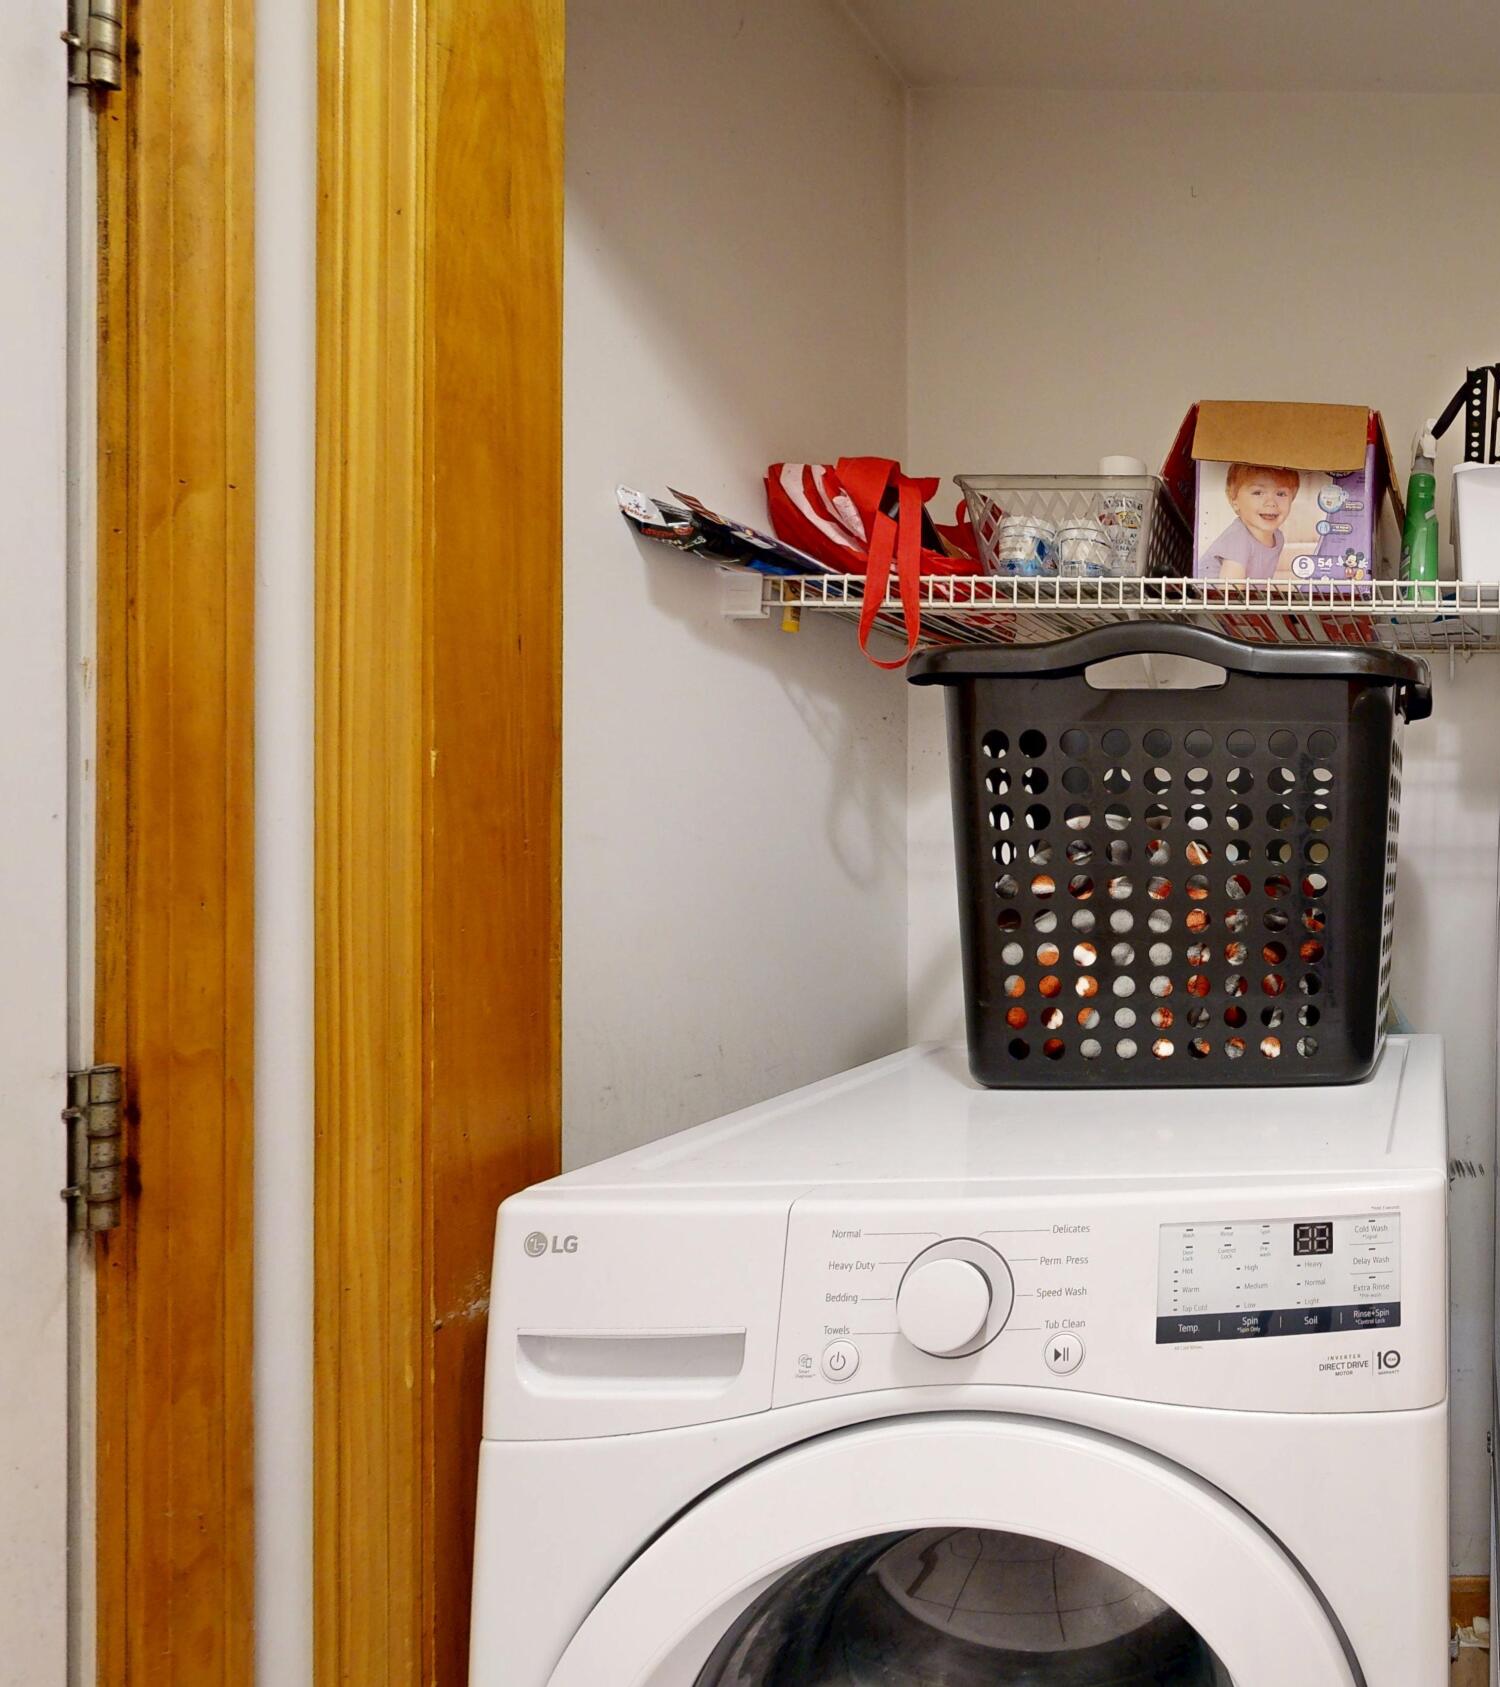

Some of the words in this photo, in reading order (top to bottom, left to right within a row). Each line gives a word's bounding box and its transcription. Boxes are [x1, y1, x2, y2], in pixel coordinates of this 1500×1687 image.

[1298, 558, 1308, 569] 6
[1318, 558, 1333, 568] 54
[832, 1229, 861, 1239] Normal
[1052, 1224, 1090, 1234] Delicates
[1354, 1225, 1370, 1234] Cold
[1370, 1224, 1388, 1232] Wash
[551, 1235, 578, 1254] LG
[1066, 1255, 1088, 1265] Press
[1304, 1260, 1322, 1268] Heavy
[1352, 1257, 1371, 1266] Delay
[1373, 1256, 1390, 1264] Wash
[828, 1260, 854, 1272] Heavy
[855, 1260, 876, 1272] Duty
[1244, 1264, 1259, 1272] High
[1244, 1282, 1269, 1290] Medium
[1304, 1278, 1326, 1286] Normal
[1353, 1284, 1370, 1292] Extra
[1372, 1282, 1390, 1290] Rinse
[1036, 1287, 1062, 1299] Speed
[1064, 1286, 1087, 1297] Wash
[825, 1292, 858, 1304] Bedding
[1304, 1298, 1320, 1306] Light
[1354, 1308, 1390, 1318] Rinse+Spin
[1044, 1320, 1060, 1329] Tub
[1062, 1318, 1086, 1328] Clean
[1242, 1316, 1258, 1326] Spin
[1304, 1316, 1318, 1325] Soil
[824, 1325, 850, 1335] Towels
[1178, 1323, 1200, 1334] Temp.
[1376, 1350, 1401, 1370] 10
[1318, 1362, 1345, 1371] DIRECT
[1346, 1360, 1369, 1370] DRIVE
